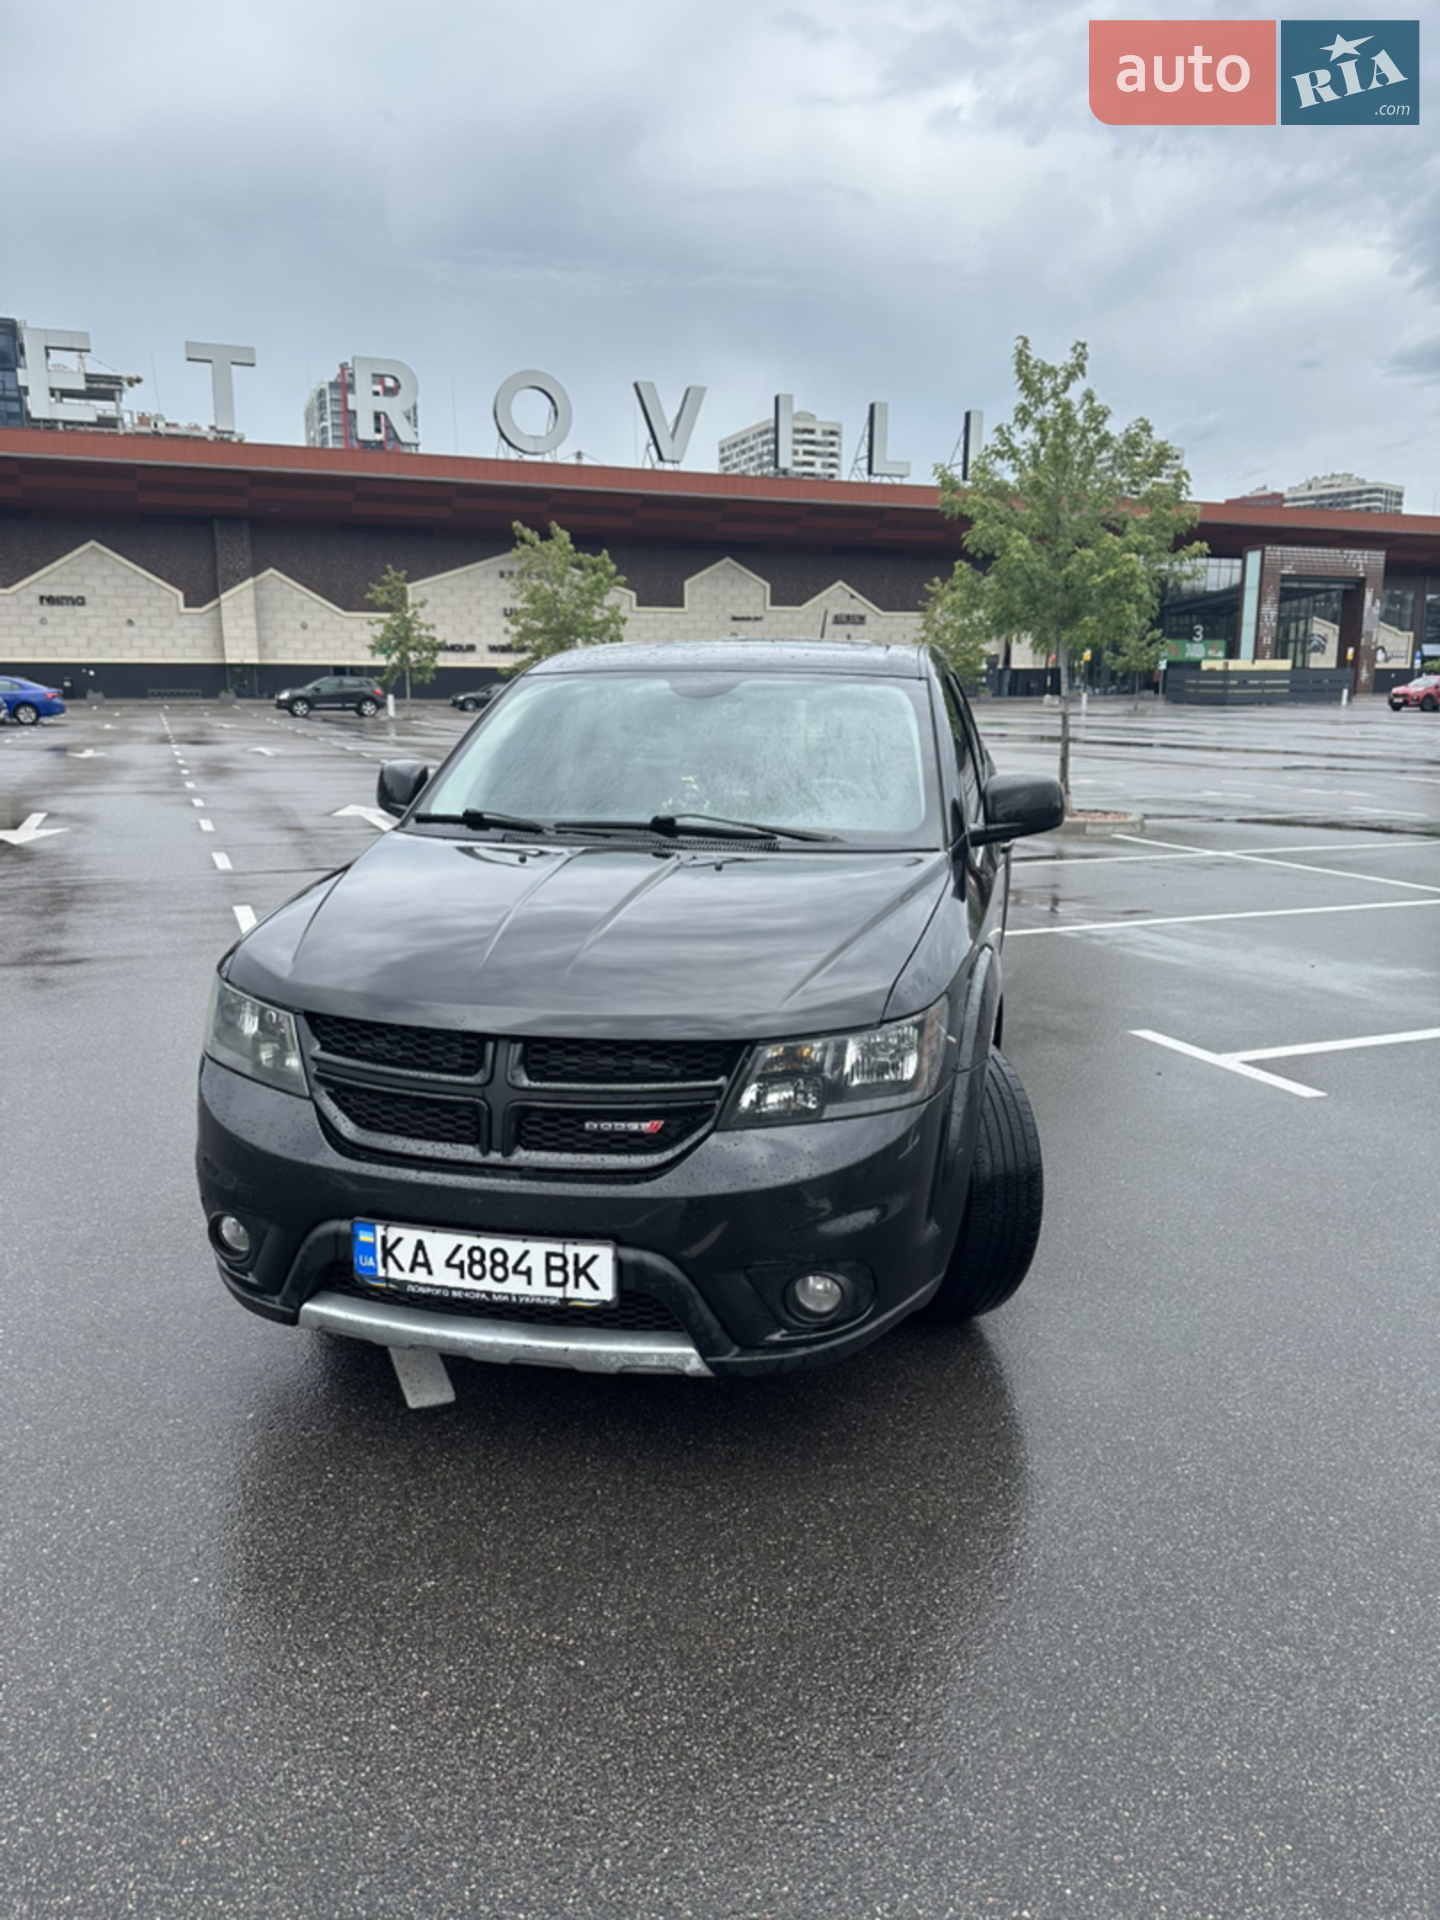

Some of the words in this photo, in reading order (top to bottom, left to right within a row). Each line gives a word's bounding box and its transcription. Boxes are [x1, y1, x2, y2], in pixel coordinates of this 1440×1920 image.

[1192, 624, 1204, 642] 3
[584, 1121, 648, 1132] DODGE
[358, 1254, 376, 1267] UA
[380, 1235, 434, 1276] KA
[444, 1243, 533, 1287] 4884
[545, 1250, 601, 1292] BK
